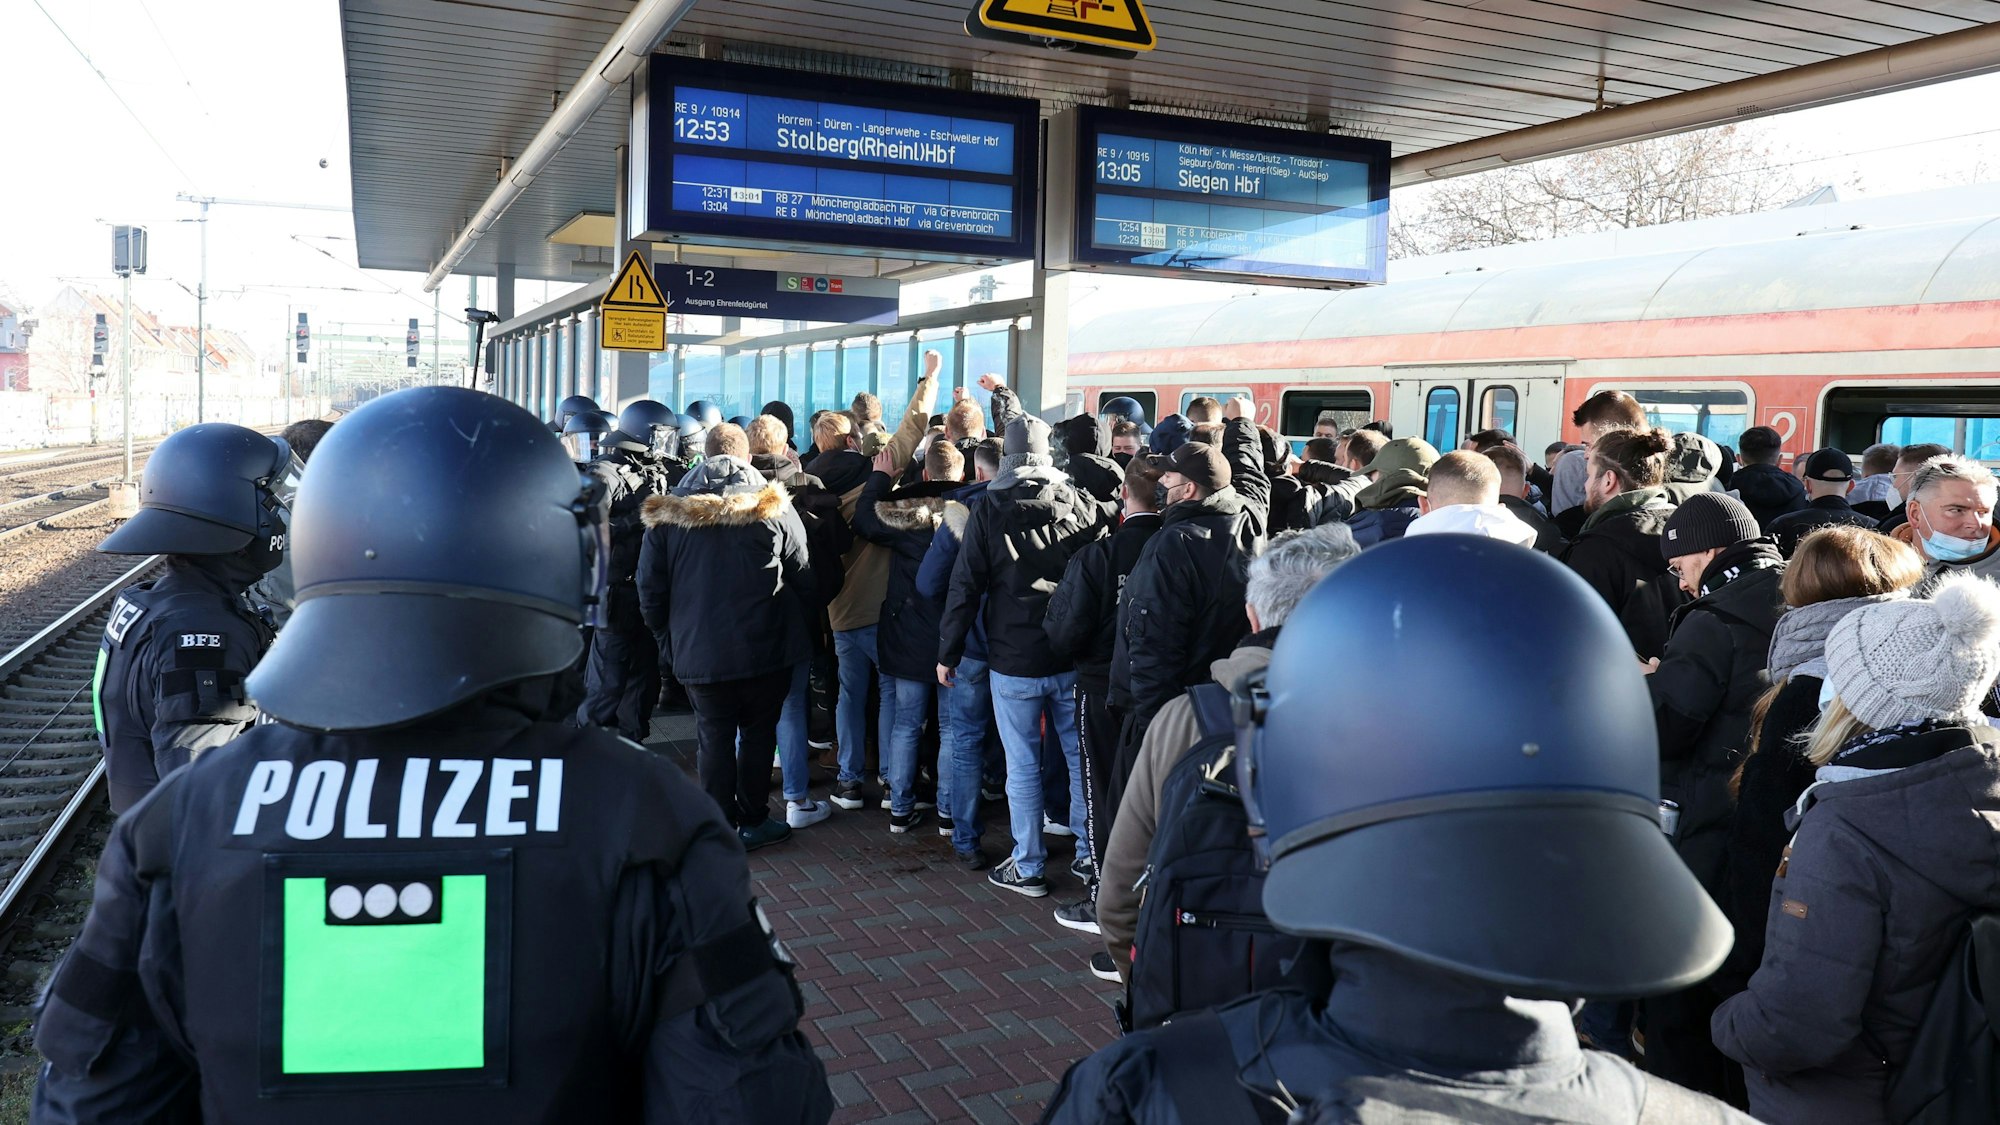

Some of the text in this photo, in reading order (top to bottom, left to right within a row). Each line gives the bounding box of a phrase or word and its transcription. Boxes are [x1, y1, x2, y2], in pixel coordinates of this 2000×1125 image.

[675, 102, 687, 113] RE
[691, 104, 698, 115] 9
[711, 106, 741, 119] 10914
[675, 117, 730, 142] 12:53
[777, 113, 813, 127] Horrem
[824, 118, 852, 131] Düren
[862, 122, 920, 138] Langerwehe
[930, 129, 981, 145] Eschweiler
[983, 135, 999, 147] Hbf
[777, 127, 956, 165] Stolberg(Rheinl)Hbf
[1097, 147, 1107, 158] RE
[1110, 148, 1116, 158] 9
[1126, 151, 1150, 162] 10915
[1179, 144, 1197, 155] Köln
[1199, 147, 1213, 157] Hbf
[1222, 149, 1227, 158] K
[1230, 150, 1281, 165] Messe/Deutz
[1289, 157, 1323, 169] Troisdorf
[1097, 160, 1141, 182] 13:05
[1179, 156, 1235, 171] Siegburg/Bonn
[1243, 164, 1291, 178] Hennef(Sieg)
[1298, 170, 1329, 182] Au(Sieg)
[1178, 169, 1260, 194] Siegen Hbf
[702, 186, 728, 199] 12:31
[776, 193, 788, 204] RB
[791, 194, 803, 205] 27
[811, 195, 897, 213] Mönchengladbach
[900, 203, 915, 215] Hbf
[923, 206, 938, 217] via
[940, 207, 1000, 222] Grevenbroich
[702, 200, 994, 234] 13:04 RE 8 Mönchengladbach Hbf via Grevenbroich
[1118, 222, 1139, 233] 12:54
[1177, 227, 1187, 238] RE
[1189, 228, 1195, 238] 8
[1200, 229, 1232, 242] Koblenz
[1118, 234, 1139, 246] 12:29
[1177, 239, 1187, 250] RB
[1189, 240, 1199, 251] 27
[686, 269, 715, 287] 1-2
[787, 276, 798, 290] S
[685, 297, 768, 310] Ausgang Ehrenfeldgürtel
[1260, 402, 1272, 426] 2
[1771, 411, 1797, 460] 2
[181, 633, 221, 647] BFE
[232, 757, 564, 841] POLIZEI
